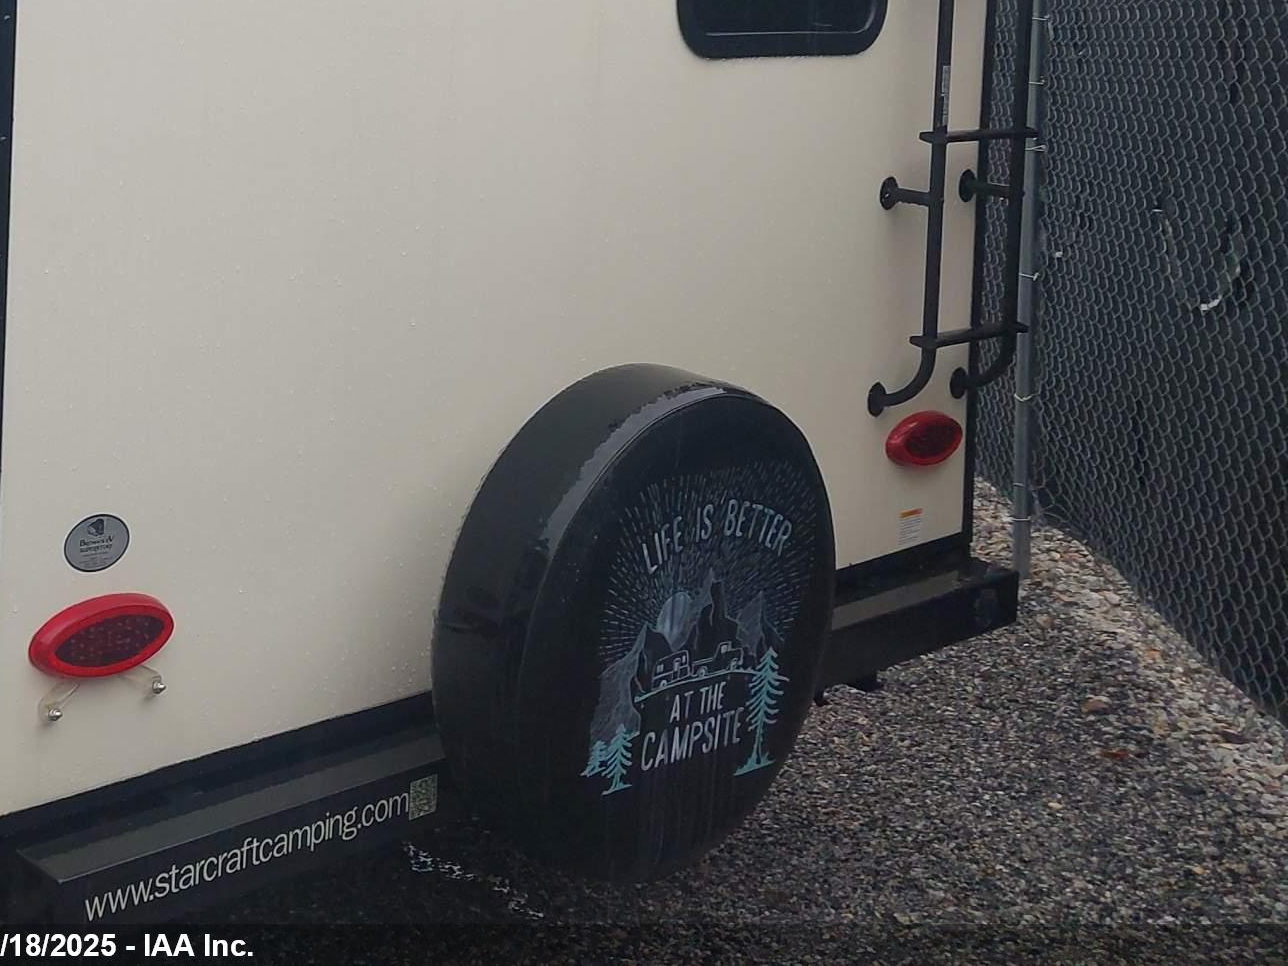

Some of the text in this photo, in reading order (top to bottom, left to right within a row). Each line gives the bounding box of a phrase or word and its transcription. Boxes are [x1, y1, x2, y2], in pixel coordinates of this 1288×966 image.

[641, 498, 792, 575] LIFE IS BETTER
[669, 682, 726, 723] AT THE
[640, 706, 745, 772] CAMPSITE
[84, 790, 410, 922] www.starcraftcamping.com
